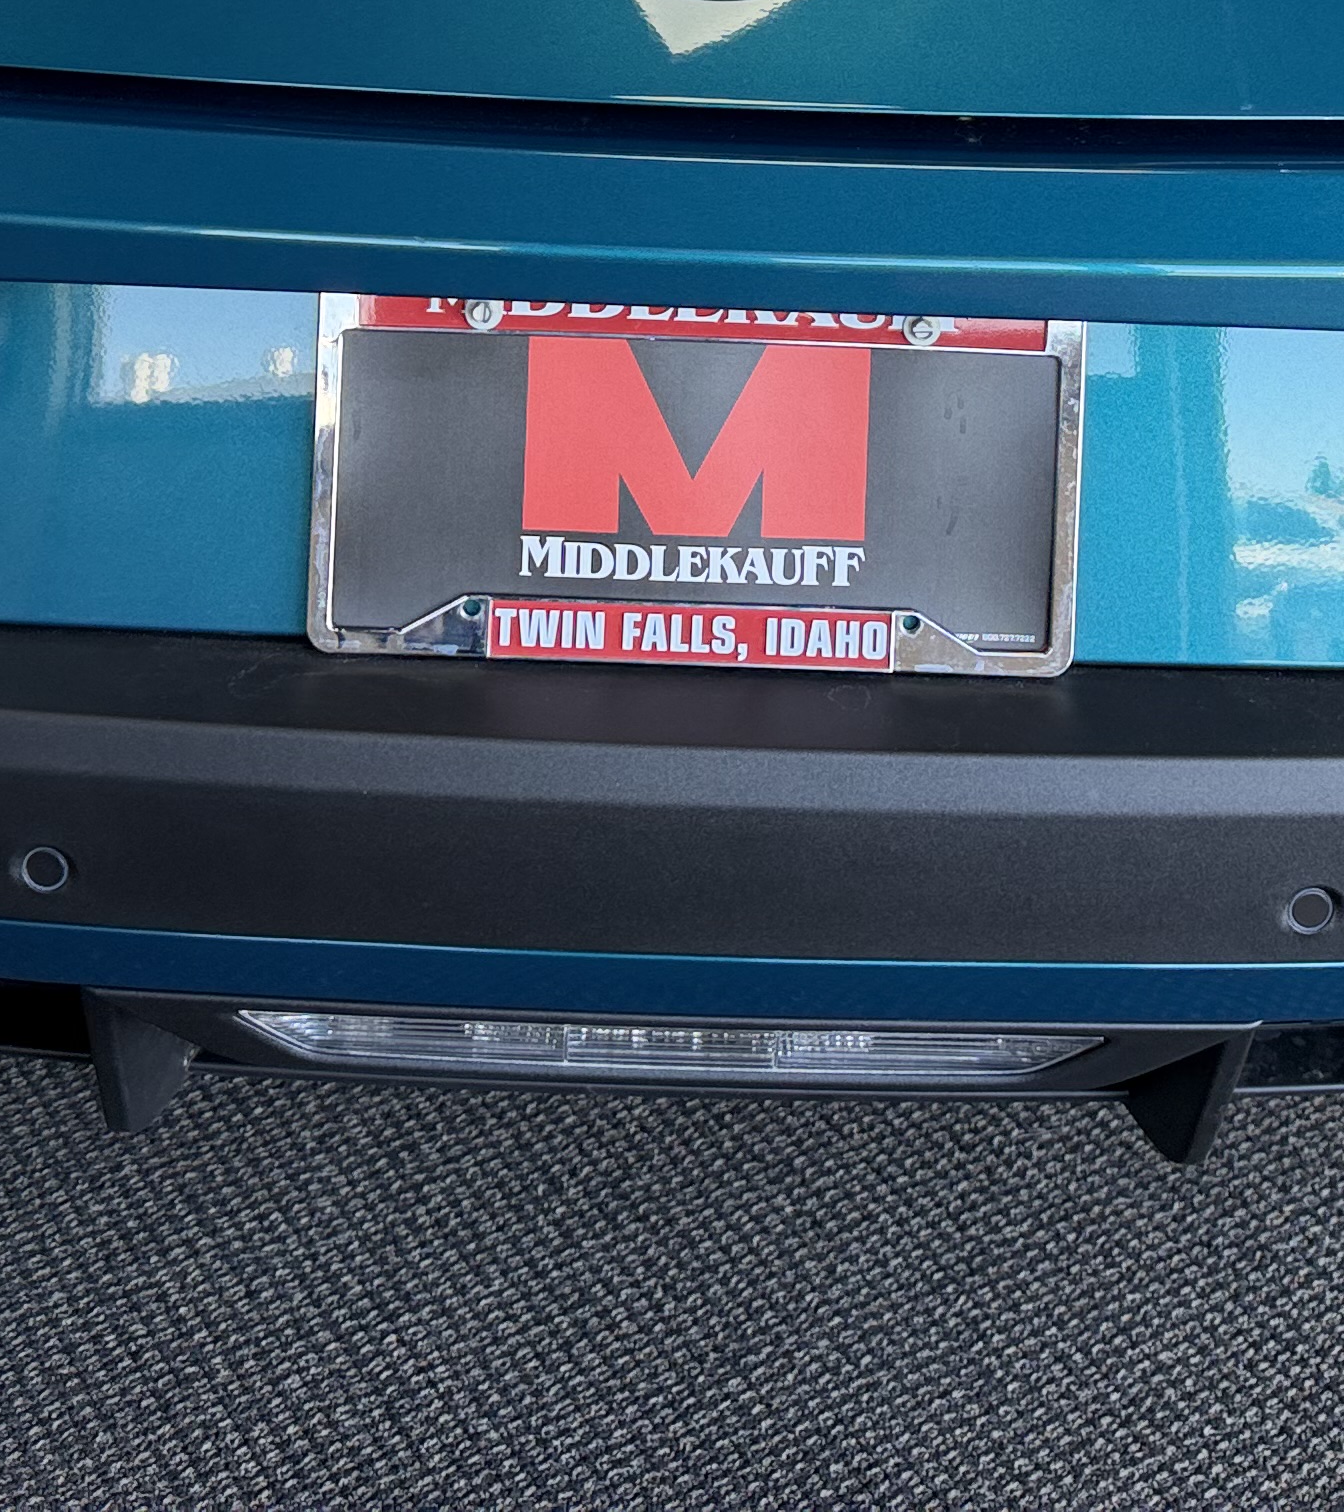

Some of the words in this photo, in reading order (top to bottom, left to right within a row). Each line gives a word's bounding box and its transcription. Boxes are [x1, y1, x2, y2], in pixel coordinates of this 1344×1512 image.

[522, 336, 871, 541] M
[519, 535, 866, 587] MIDDLEKAUFF
[494, 607, 606, 650] TWIN
[621, 612, 749, 662] FALLS,
[764, 617, 889, 661] IDAHO
